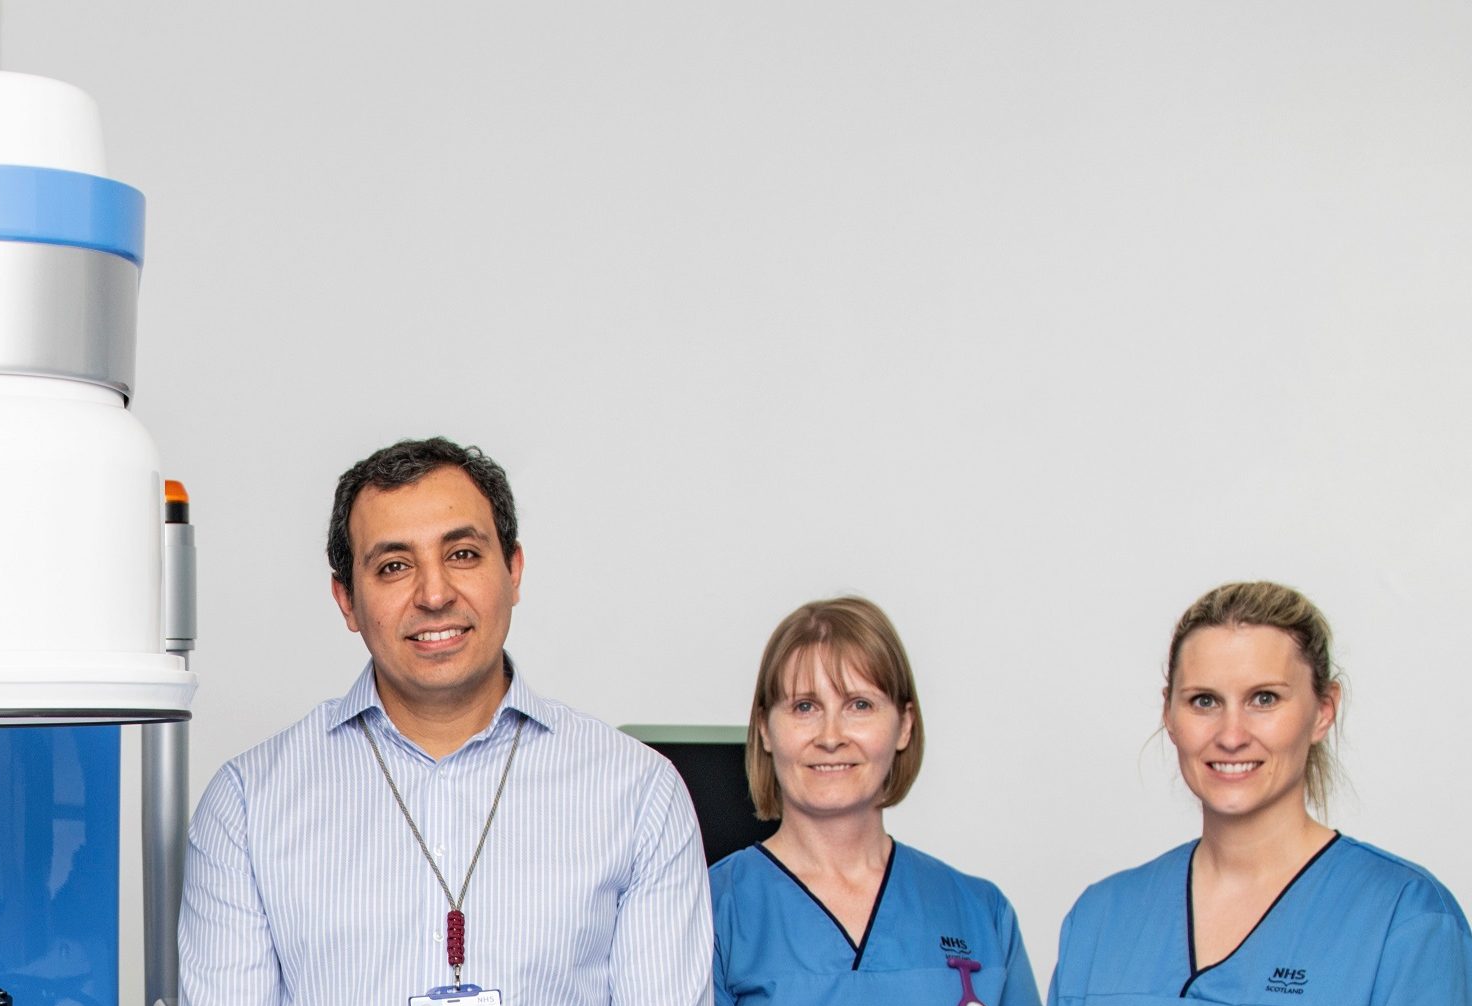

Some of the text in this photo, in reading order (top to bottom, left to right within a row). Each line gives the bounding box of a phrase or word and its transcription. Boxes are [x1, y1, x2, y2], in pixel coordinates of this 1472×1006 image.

[941, 935, 967, 950] NHS
[1272, 967, 1306, 980] NHS
[1265, 985, 1304, 995] SCOTLAND
[477, 995, 495, 1004] NHS
